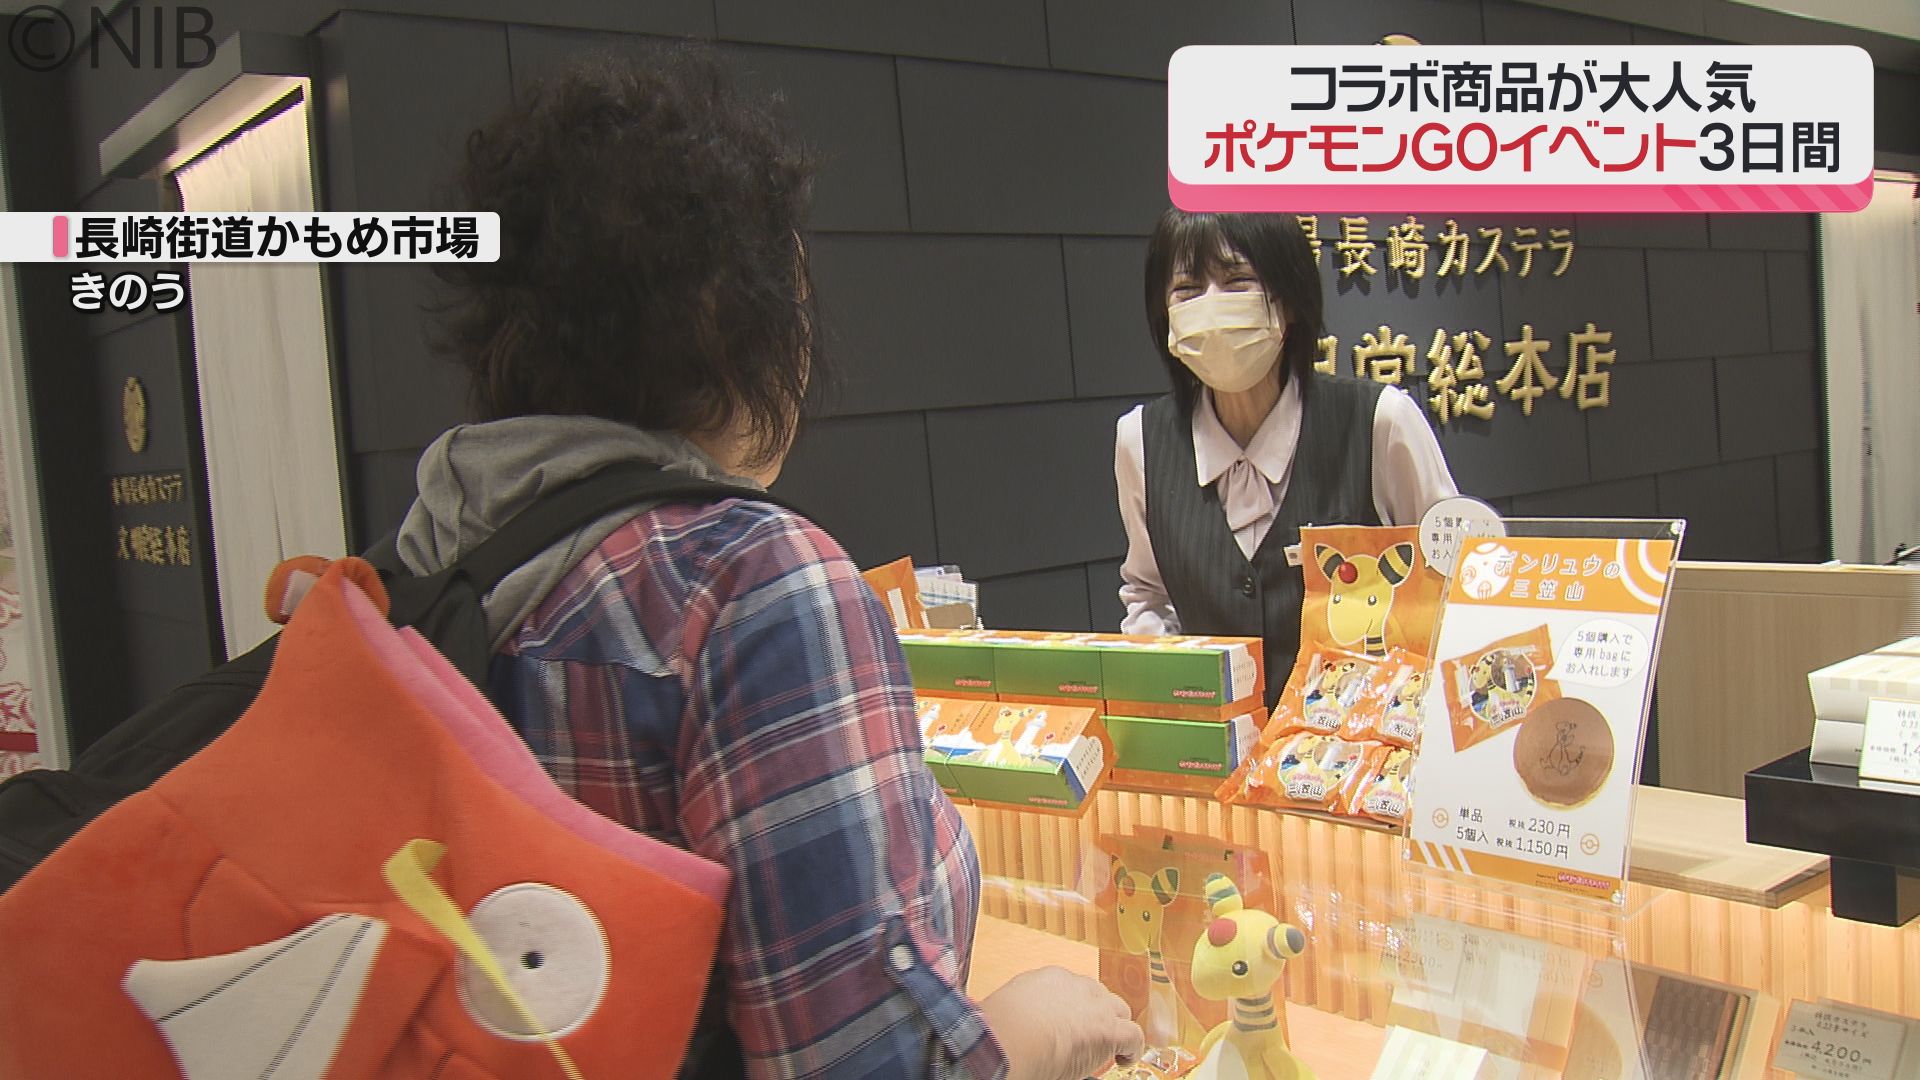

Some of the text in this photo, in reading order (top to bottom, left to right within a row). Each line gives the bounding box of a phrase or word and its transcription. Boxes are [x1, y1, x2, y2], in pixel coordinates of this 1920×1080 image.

[1496, 551, 1621, 579] デンリュウの
[1510, 580, 1585, 600] 三笠山
[1458, 806, 1483, 823] 単品
[1527, 817, 1571, 840] 230円
[1456, 826, 1490, 845] 5個入
